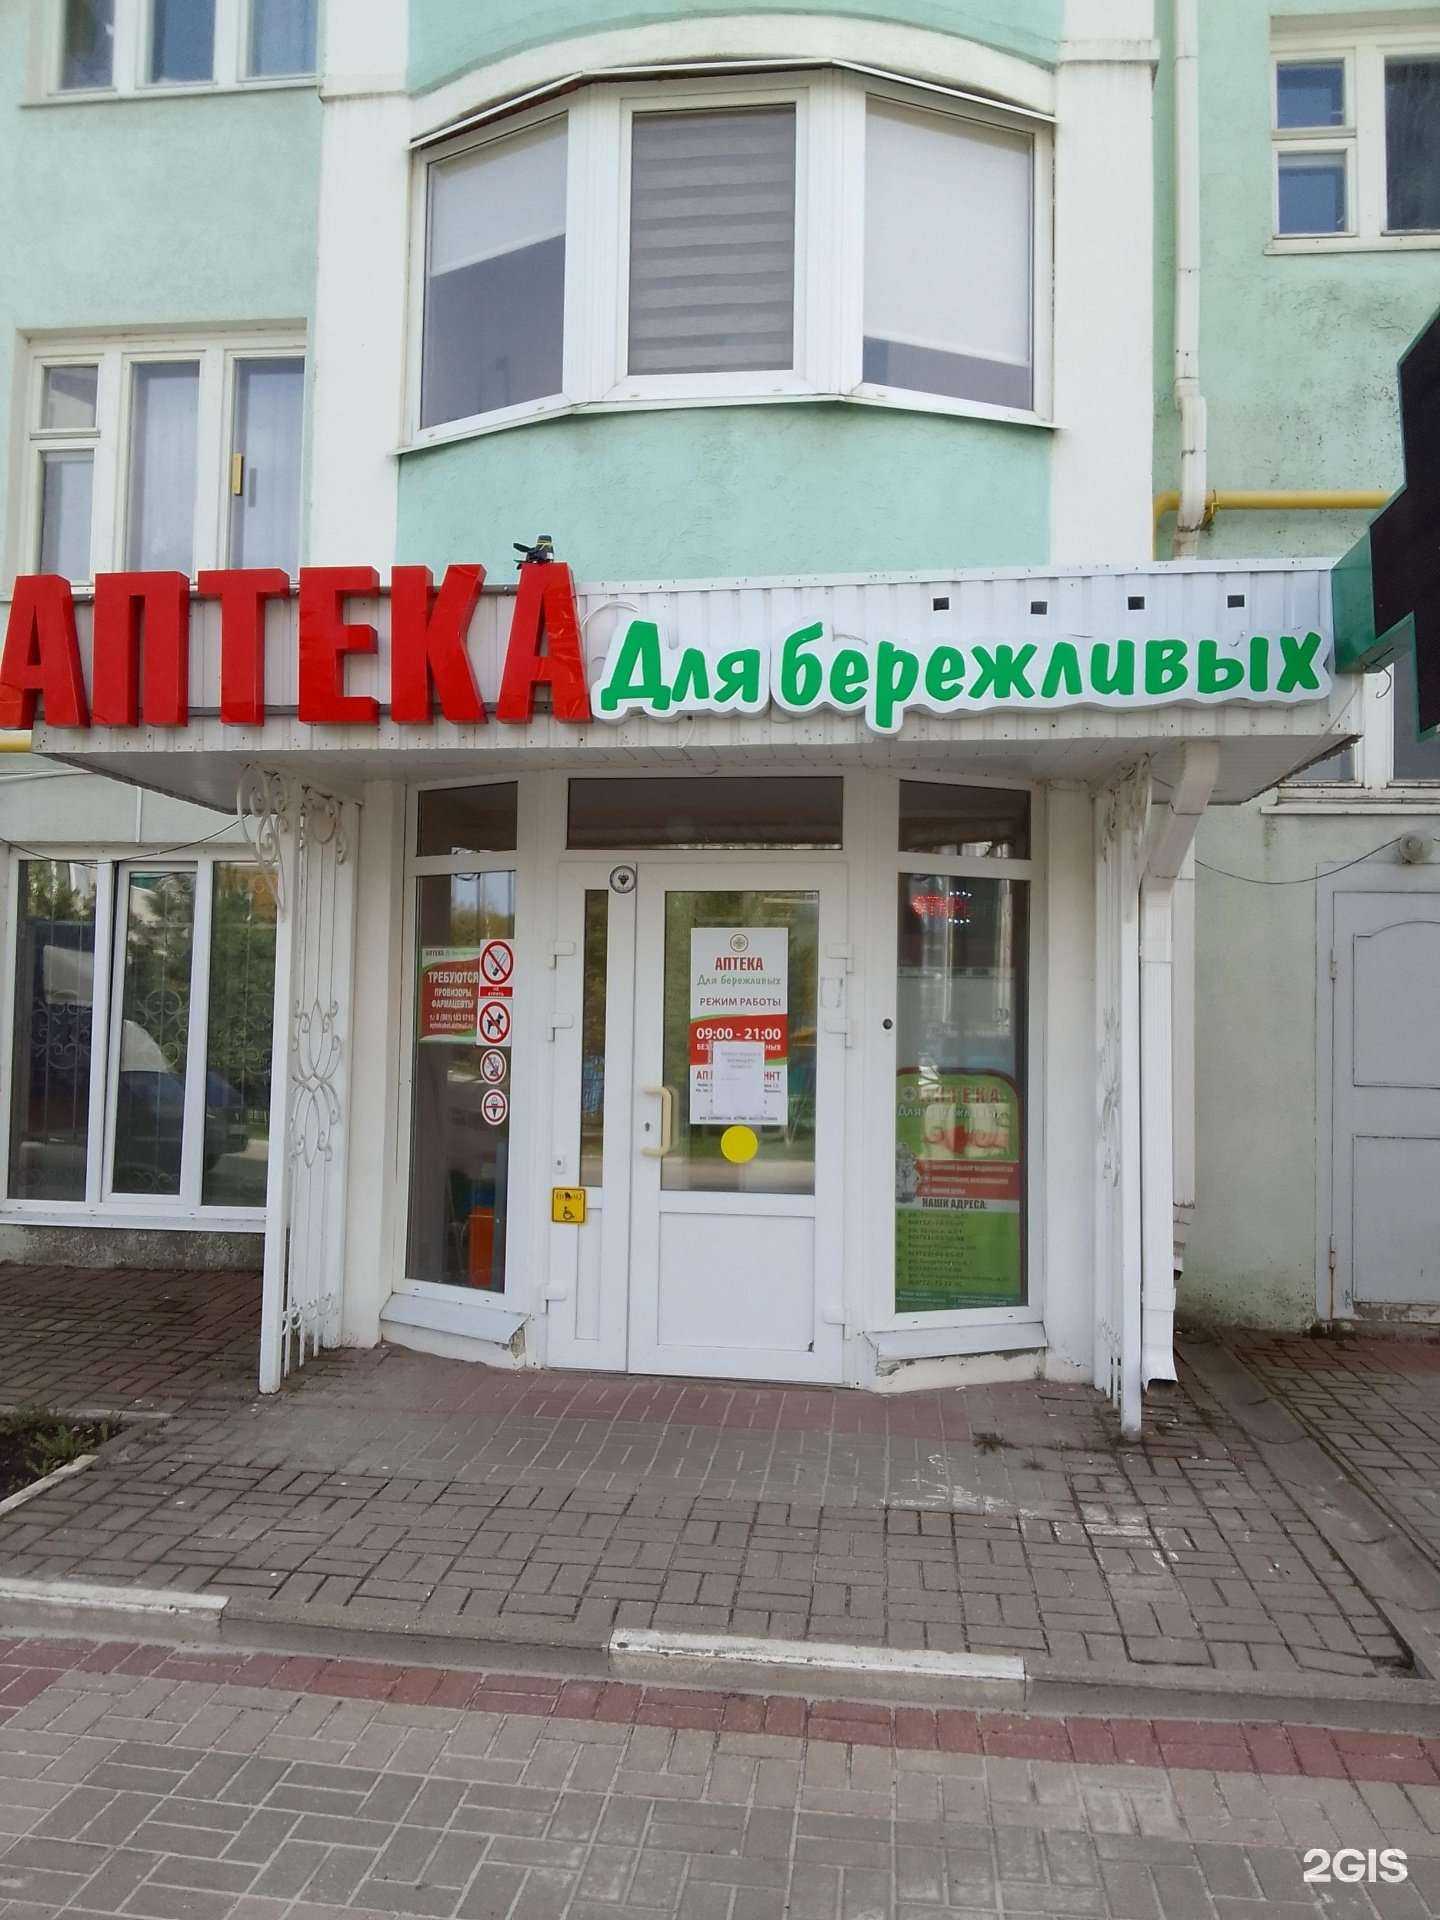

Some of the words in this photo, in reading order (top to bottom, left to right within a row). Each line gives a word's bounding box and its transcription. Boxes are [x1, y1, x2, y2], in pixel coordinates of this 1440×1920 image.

[0, 563, 592, 729] АПТЕКА
[601, 620, 762, 711] Для
[781, 622, 1322, 728] бережливых
[715, 957, 764, 971] АПТЕКА
[428, 971, 479, 984] ТРЕБУЮТСЯ
[697, 975, 718, 986] Для
[700, 998, 738, 1007] РЕЖИМ
[739, 998, 781, 1007] РАБОТЫ
[696, 1028, 733, 1040] 09:00
[744, 1028, 782, 1041] 21:00
